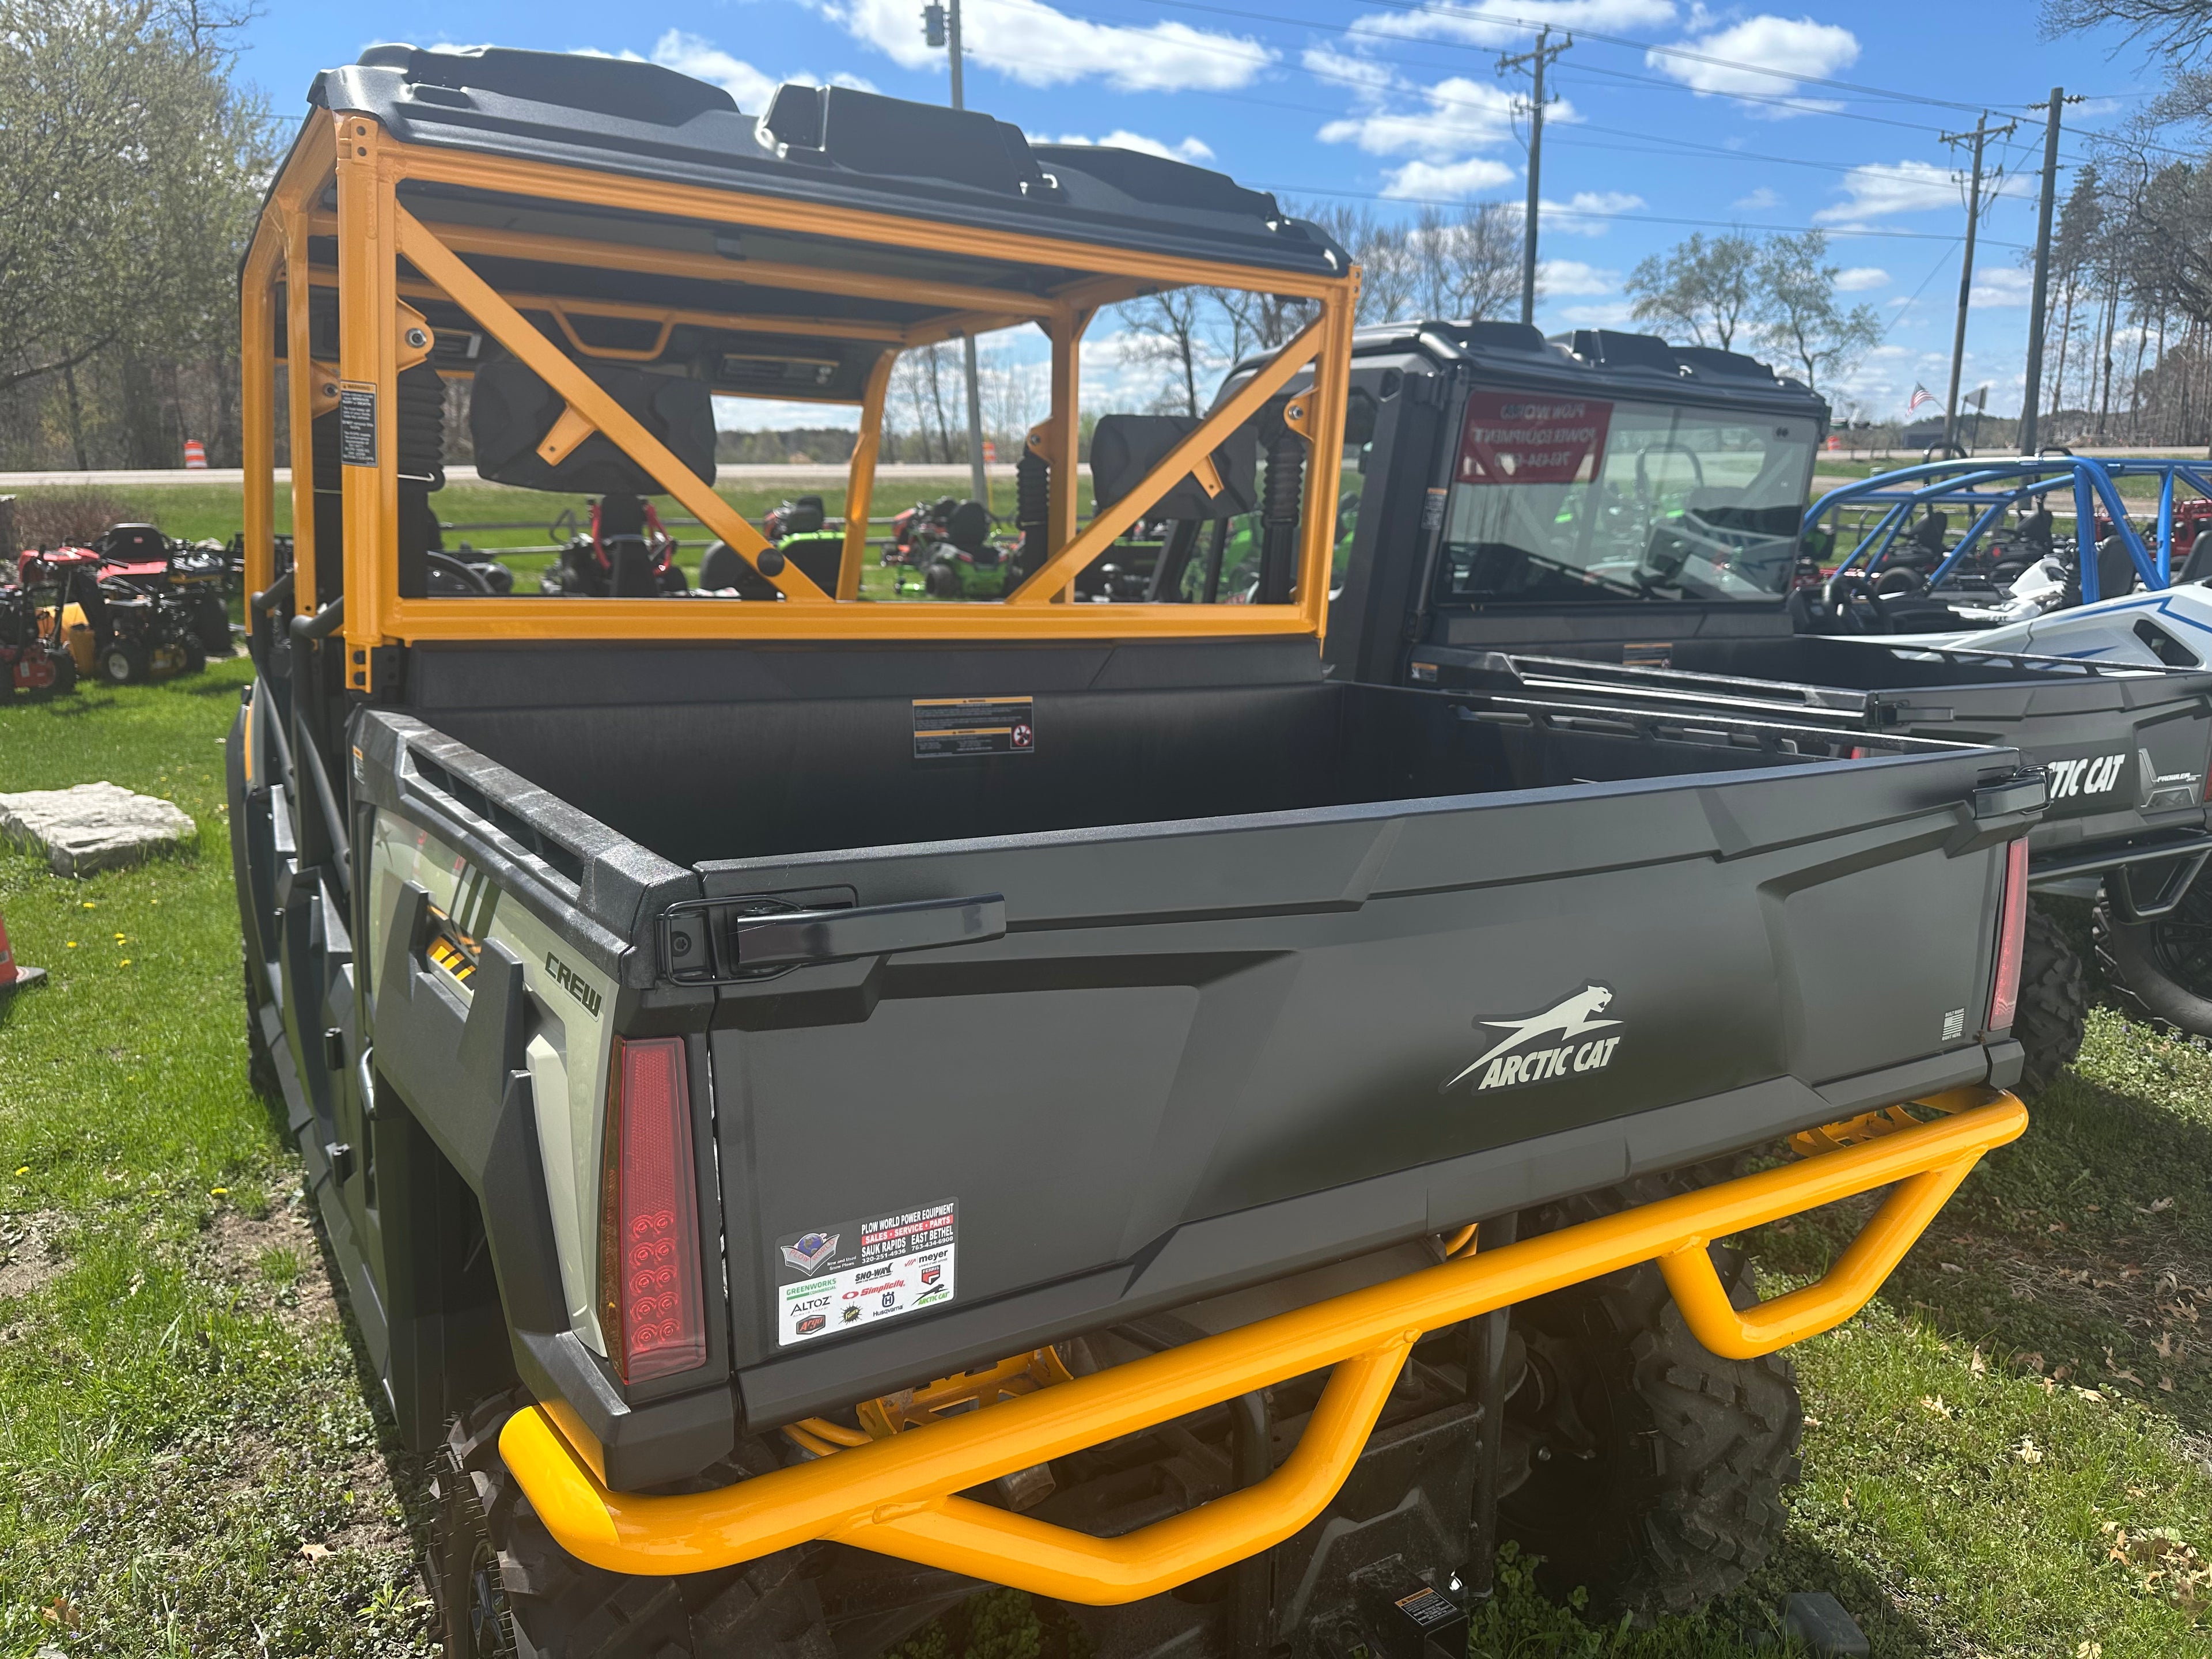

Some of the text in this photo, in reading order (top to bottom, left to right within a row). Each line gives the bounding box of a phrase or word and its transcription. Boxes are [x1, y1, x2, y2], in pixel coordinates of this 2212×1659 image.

[2084, 753, 2126, 794] CAT
[544, 951, 602, 1017] CREW
[1478, 1036, 1620, 1090] ARCTIC CAT
[862, 1203, 954, 1234] PLOW WORLD POWER EQUIPMENT
[865, 1216, 950, 1244] SALES SERVICE PARTS
[911, 1225, 954, 1245] EAST BETHEL
[812, 1239, 835, 1260] WORLD
[862, 1237, 906, 1257] SAUK RAPIDS
[911, 1236, 954, 1251] 763-434-6900
[789, 1249, 809, 1263] PLOW
[862, 1248, 906, 1264] 320-251-4936
[919, 1249, 948, 1263] meyer
[855, 1262, 894, 1282] SNO-WAY
[786, 1278, 836, 1296] GREENWORKS
[810, 1286, 836, 1296] COMMERCIAL
[861, 1279, 904, 1297] Simplicity
[790, 1296, 831, 1316] ALTOZ
[918, 1295, 938, 1305] ARCTIC
[873, 1304, 903, 1317] Husqvarna
[799, 1317, 823, 1332] Argo
